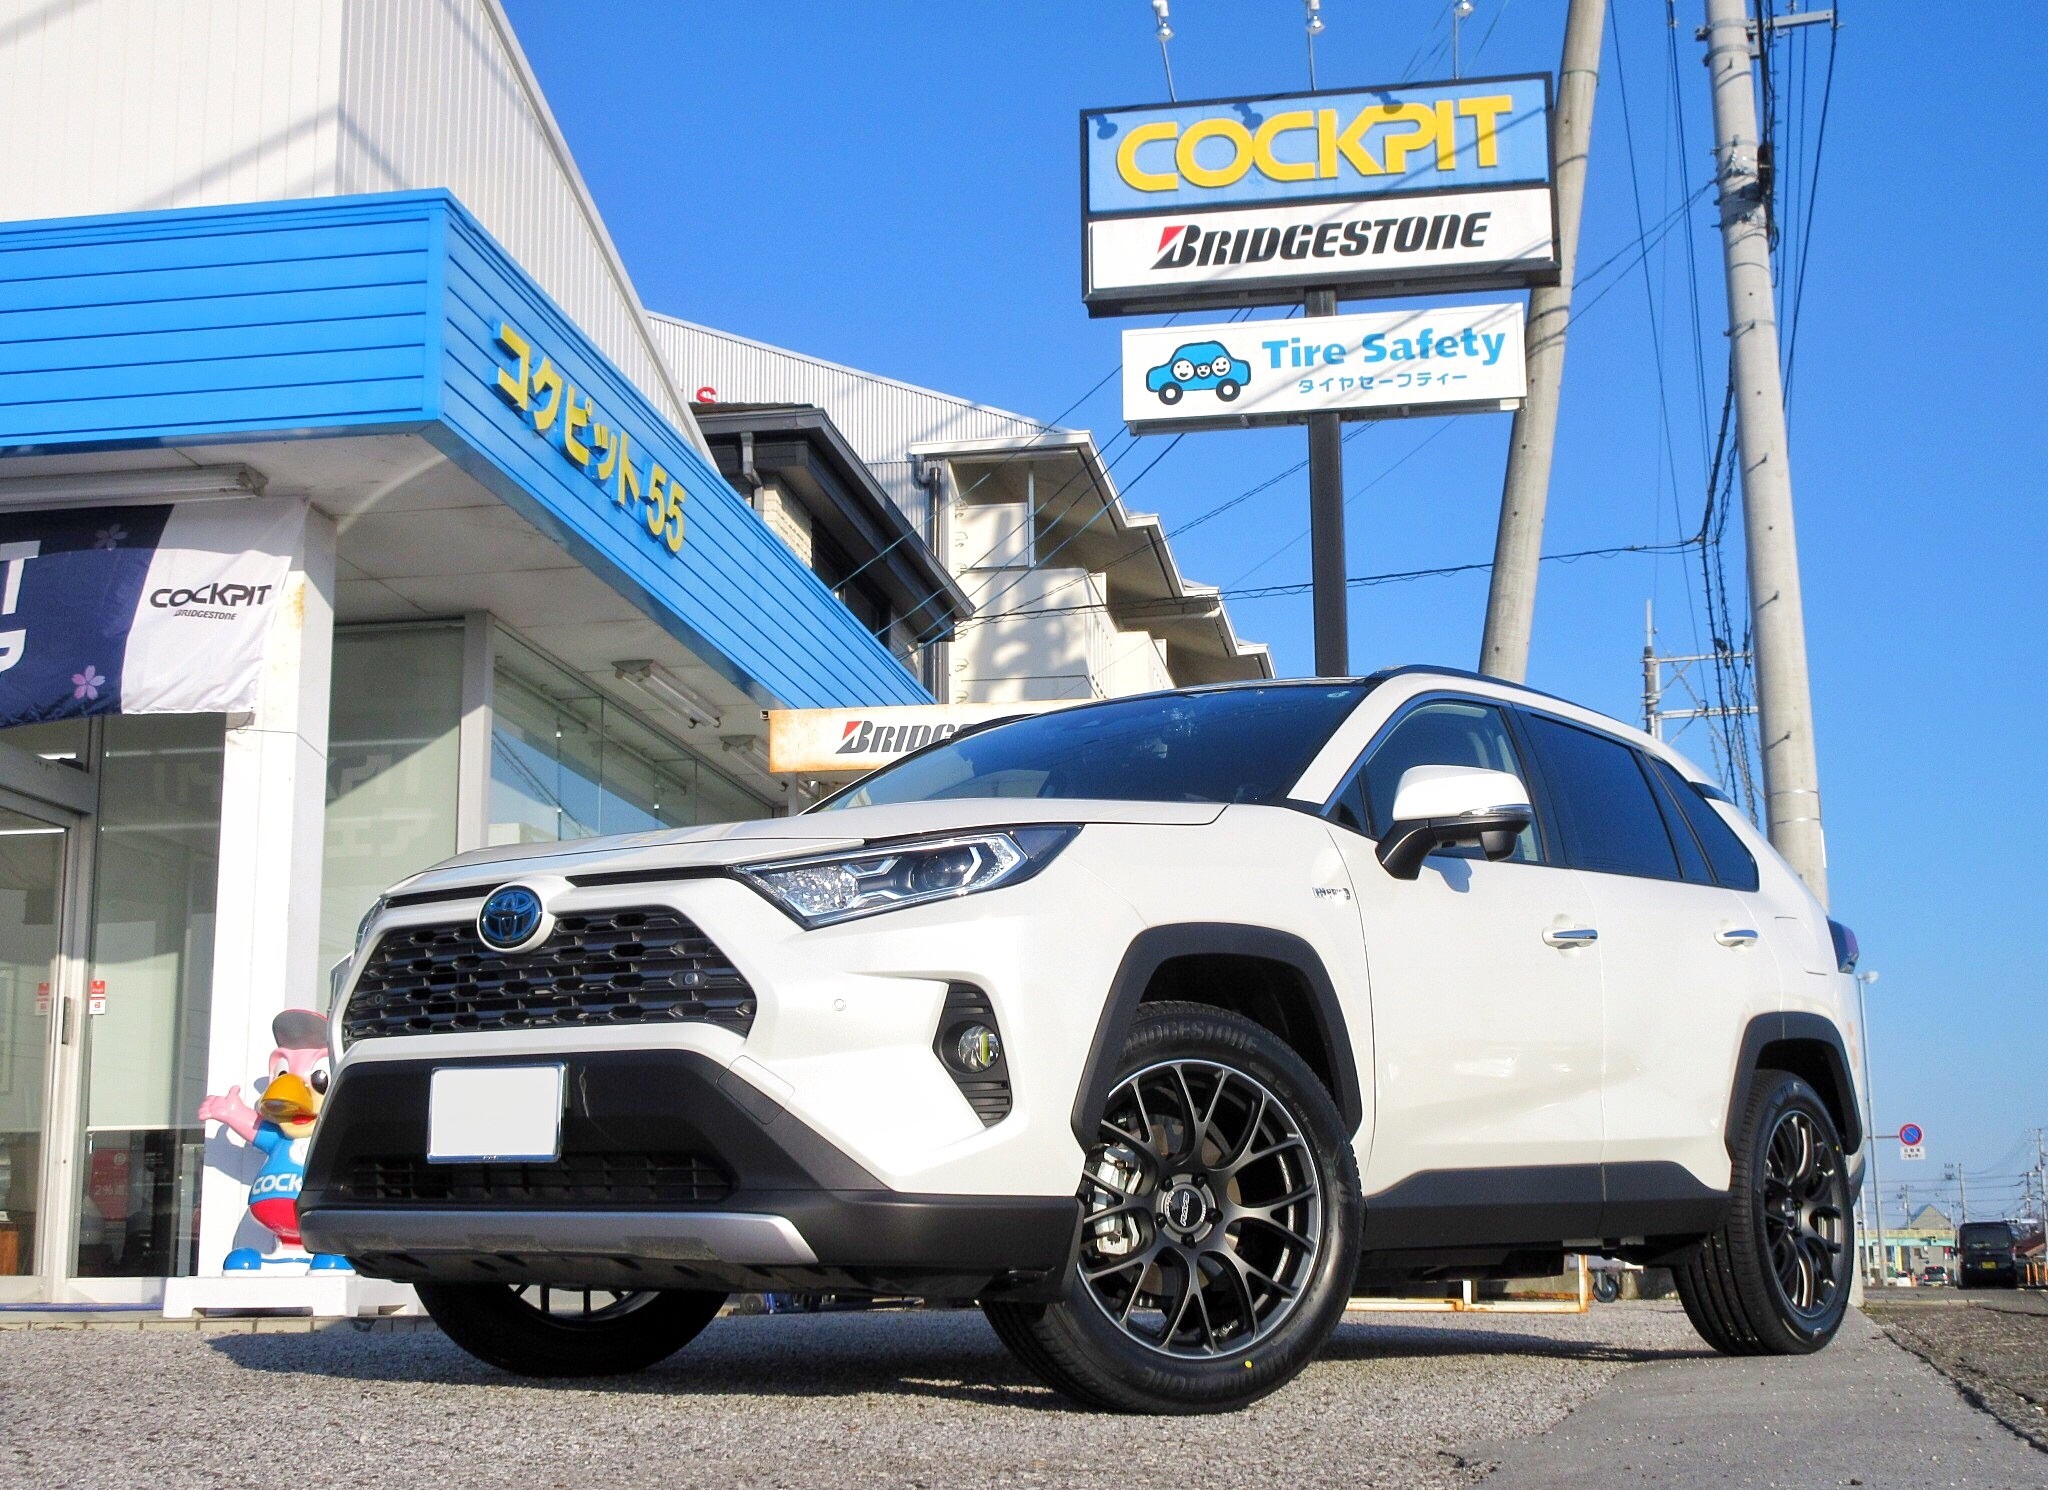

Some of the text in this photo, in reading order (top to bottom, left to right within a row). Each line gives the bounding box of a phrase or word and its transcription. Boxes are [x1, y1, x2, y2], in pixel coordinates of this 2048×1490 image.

[1116, 94, 1512, 192] COCKPIT
[1150, 211, 1491, 270] BRIDGESTONE
[1262, 327, 1505, 369] Tire Safety
[1299, 371, 1467, 394] タイヤセーフティー
[150, 582, 272, 608] COCKPIT
[174, 609, 237, 621] BRIDGESTONE
